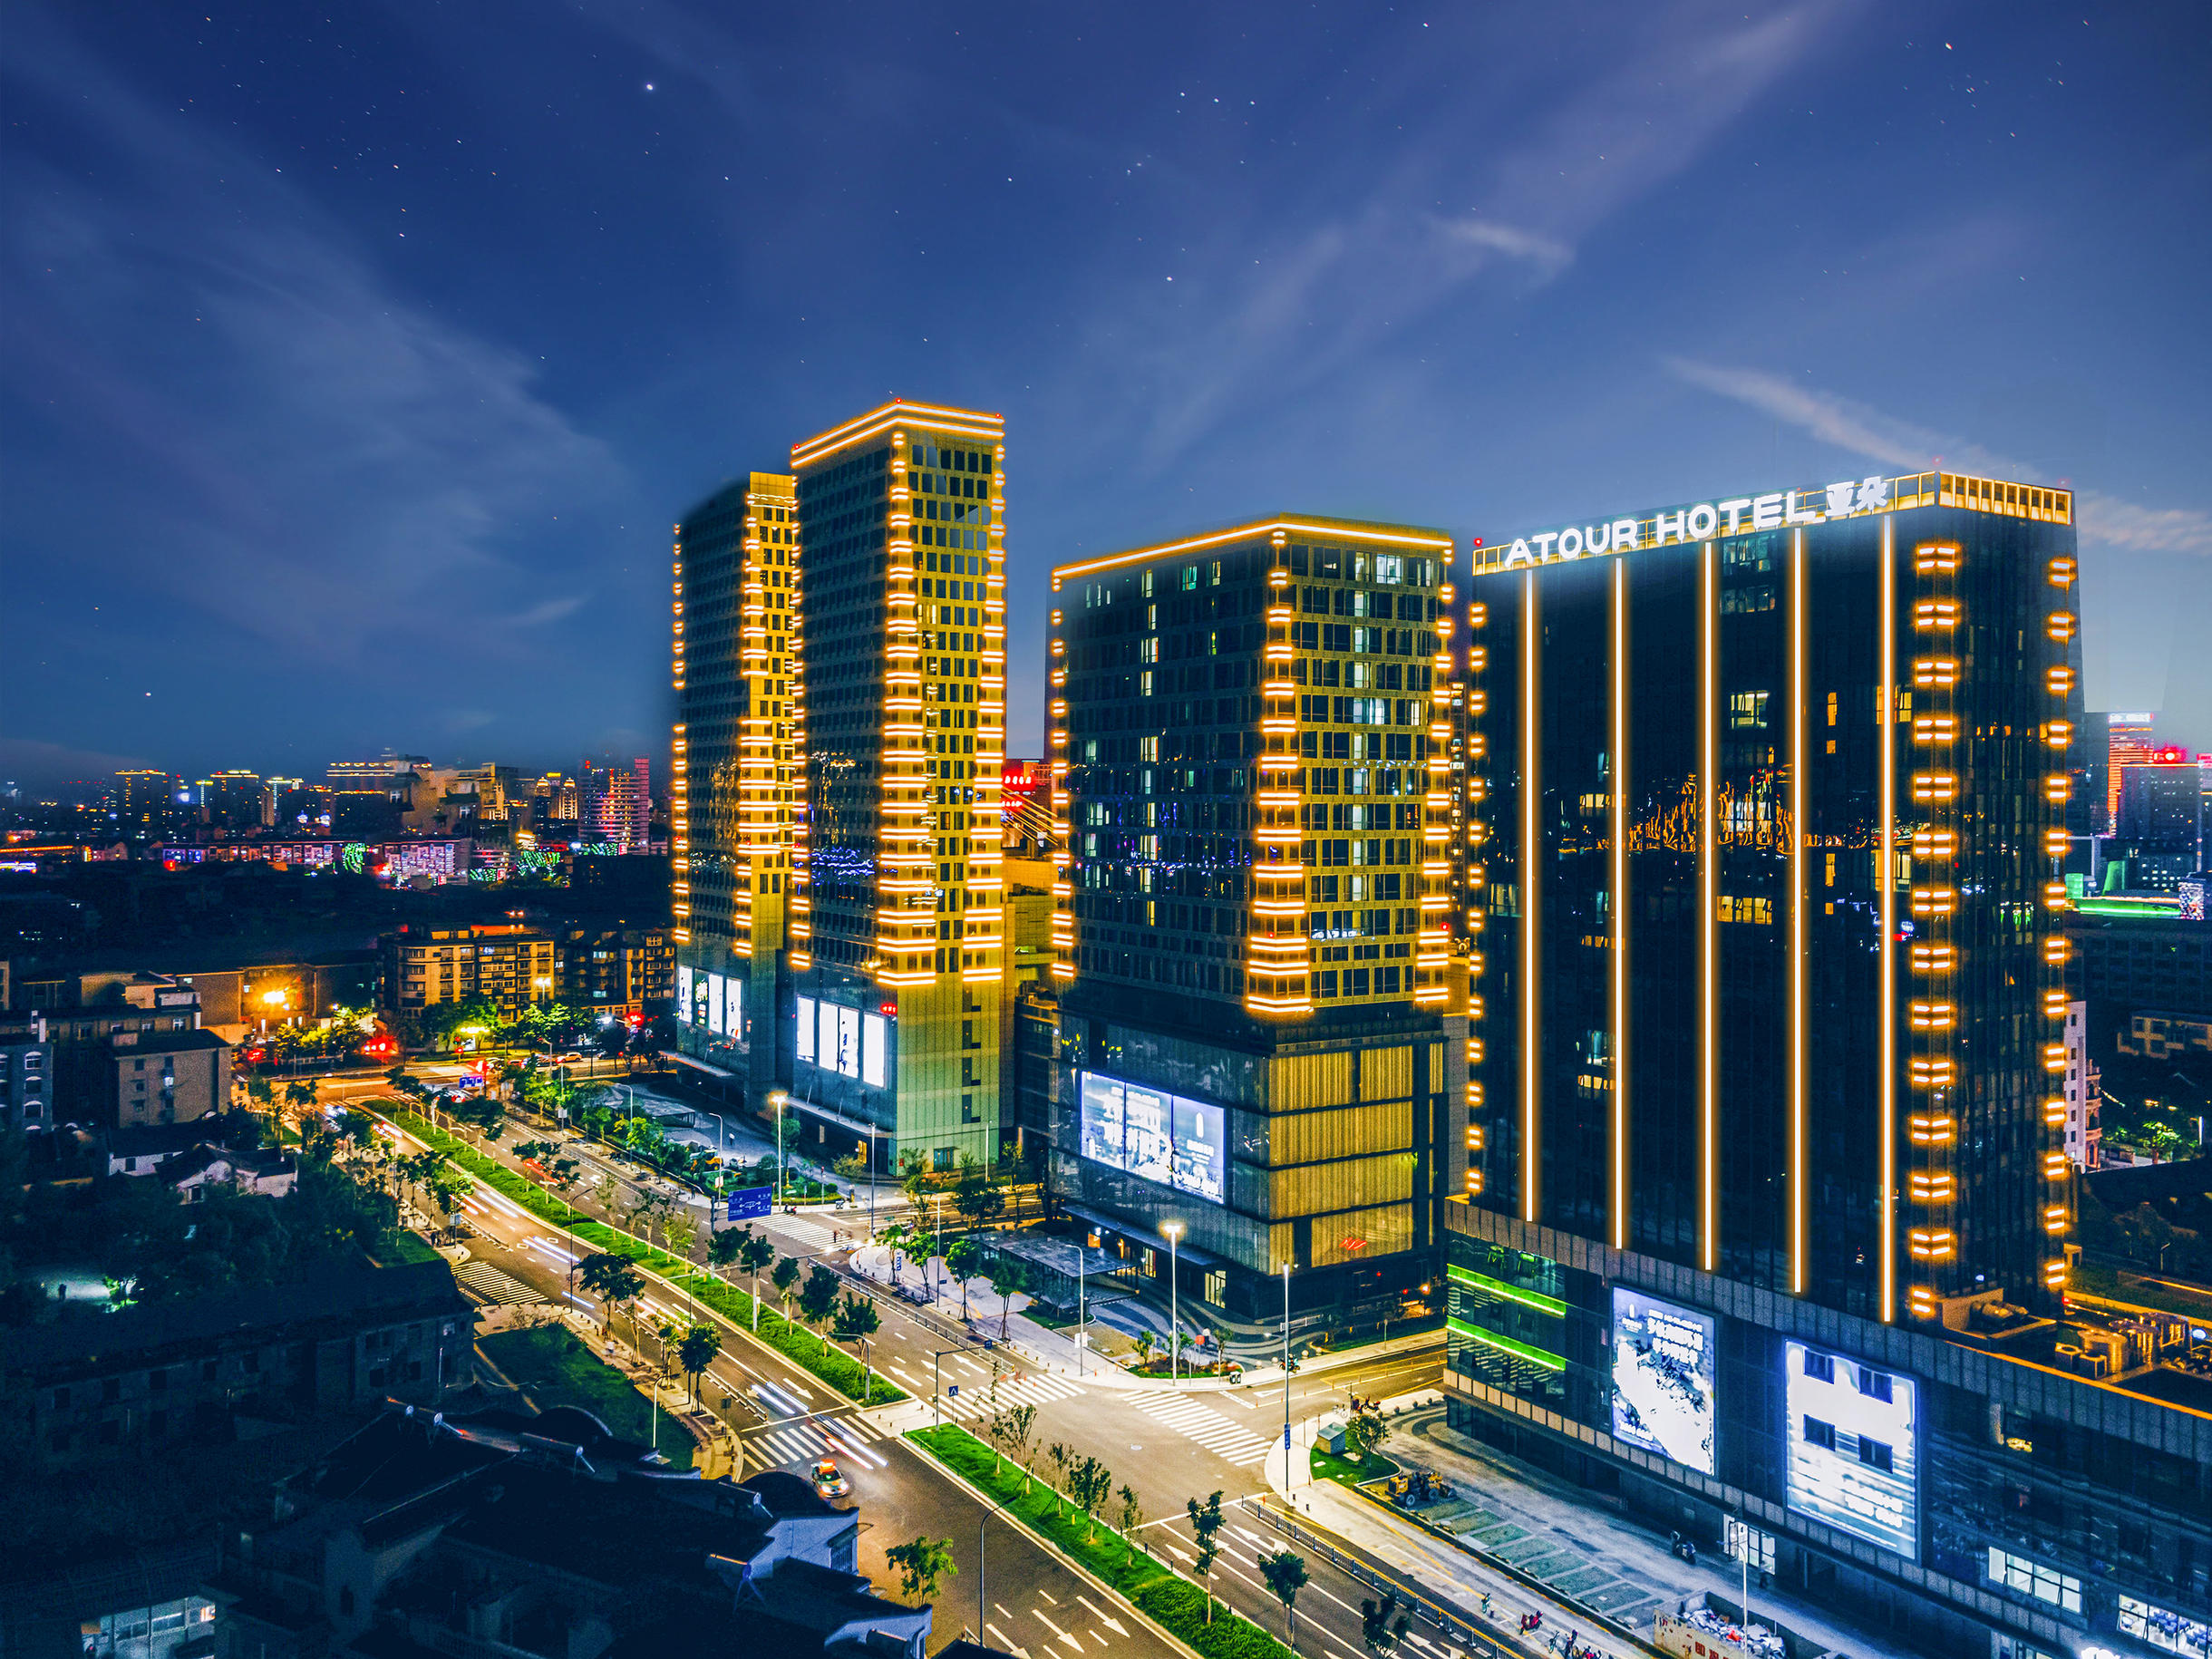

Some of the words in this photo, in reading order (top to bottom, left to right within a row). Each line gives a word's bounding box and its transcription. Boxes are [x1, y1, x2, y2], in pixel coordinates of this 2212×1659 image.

[1825, 476, 1887, 517] 亚朵
[1504, 519, 1638, 568] ATOUR
[1656, 490, 1817, 543] HOTEL
